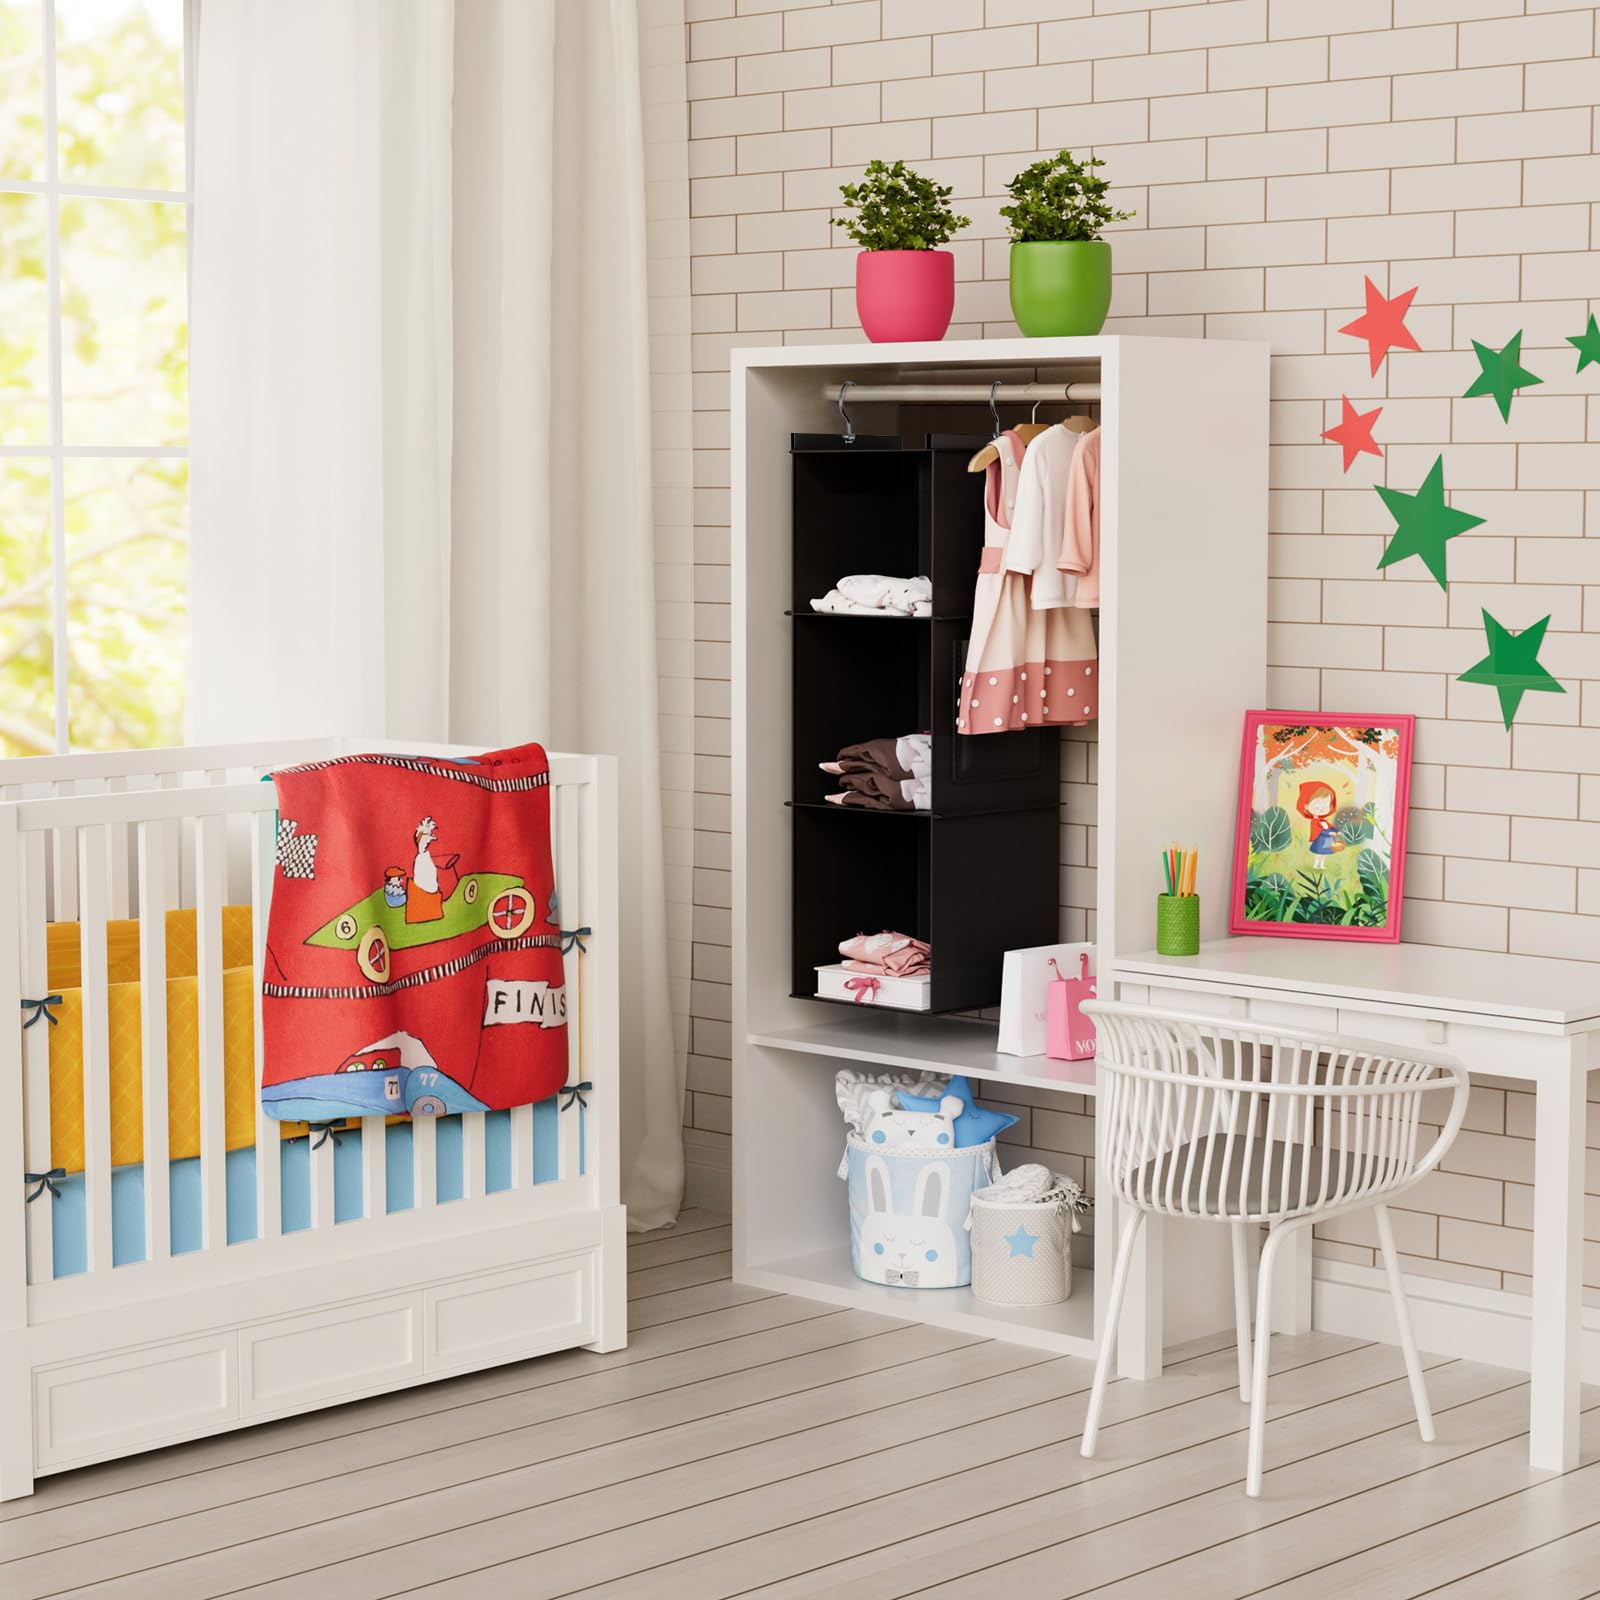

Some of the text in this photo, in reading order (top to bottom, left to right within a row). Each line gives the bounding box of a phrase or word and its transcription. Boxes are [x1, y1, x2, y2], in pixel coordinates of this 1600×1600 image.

[340, 921, 351, 934] 6
[420, 1073, 438, 1088] 77
[388, 1081, 399, 1095] 77
